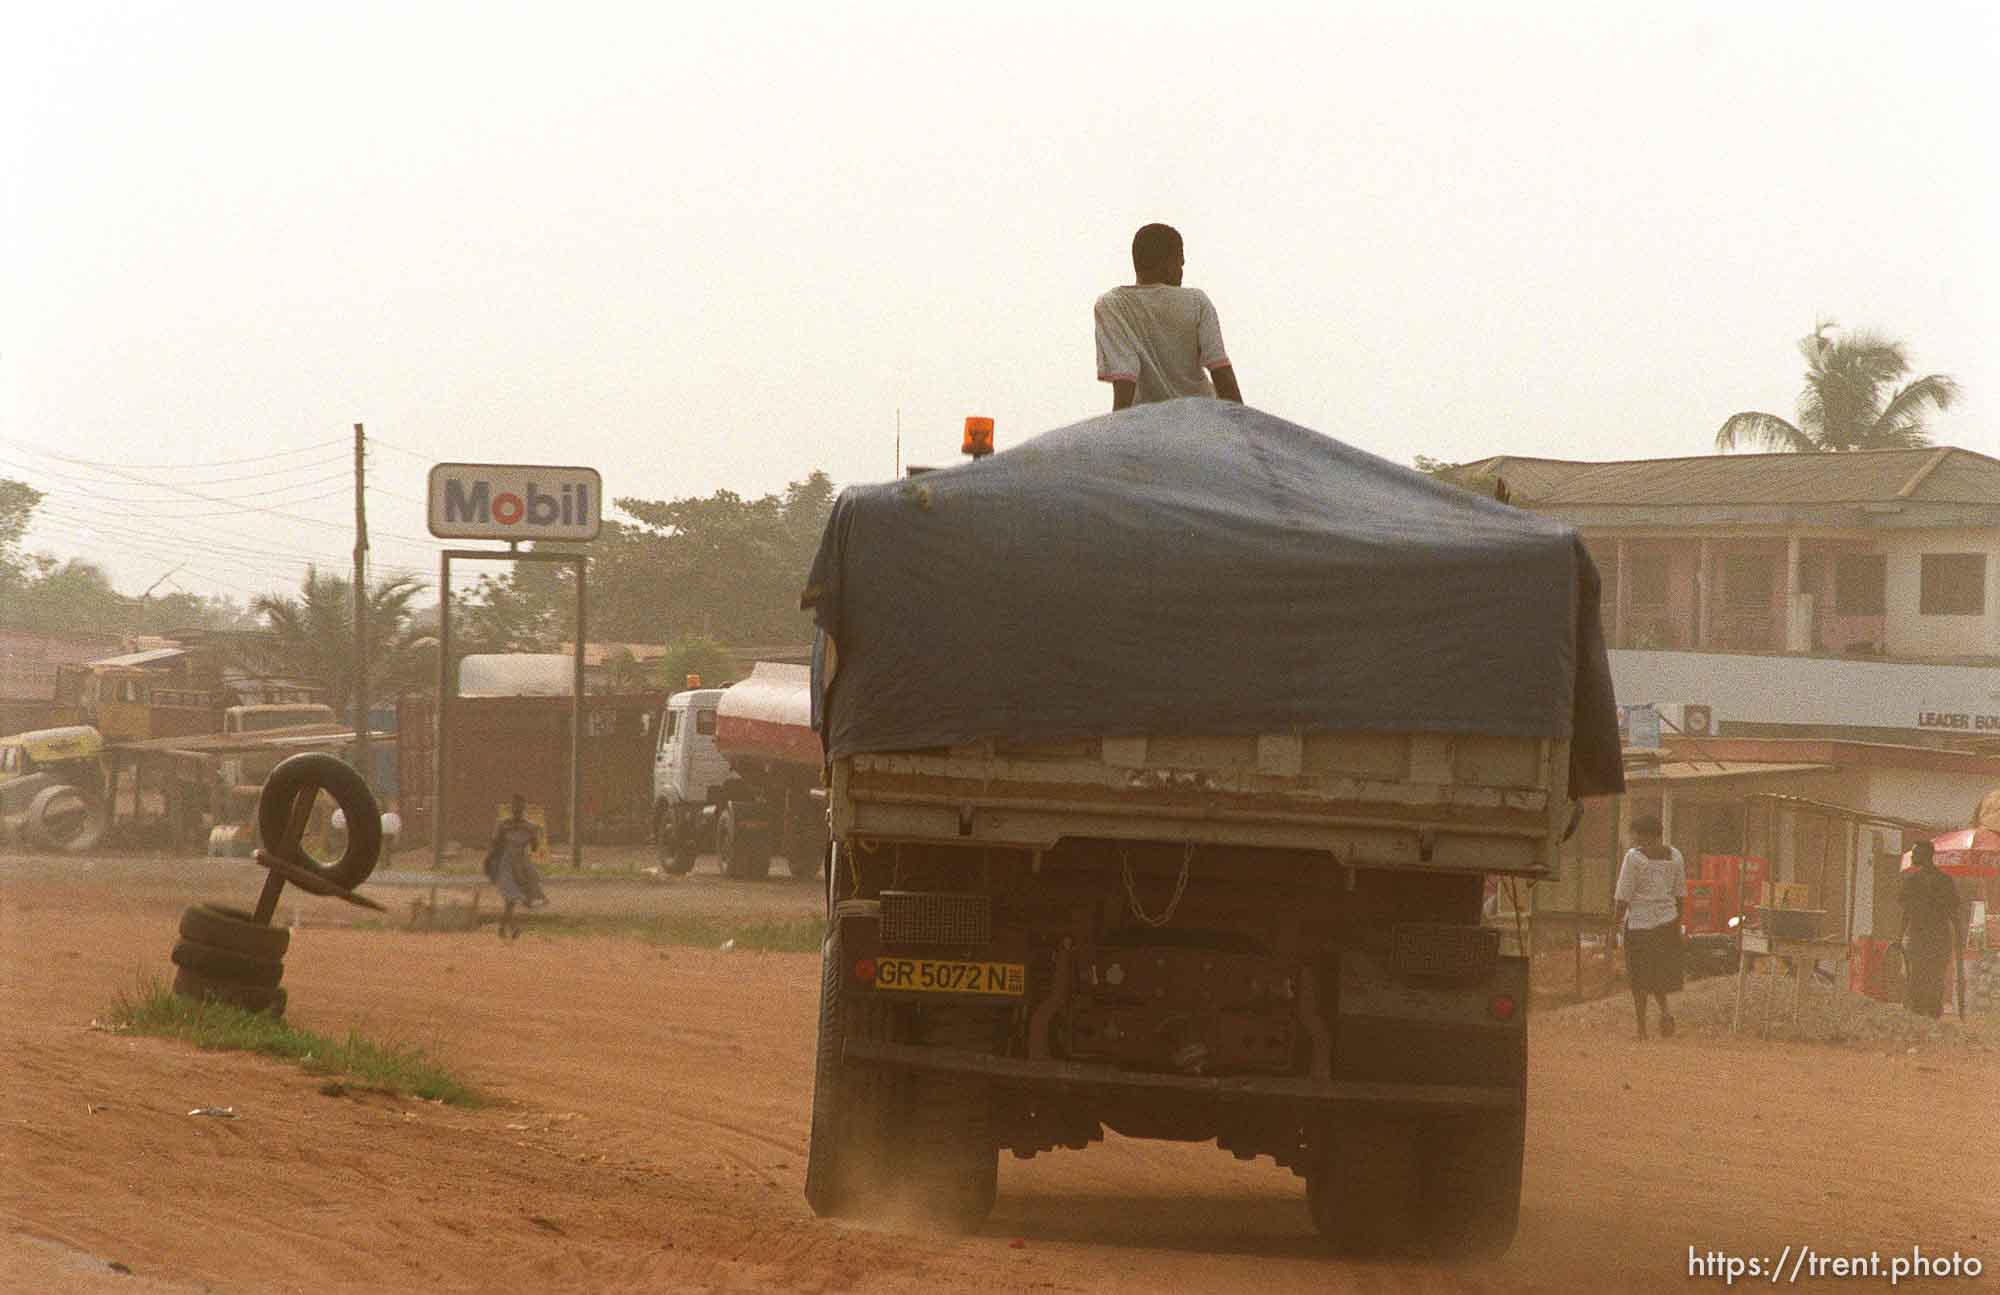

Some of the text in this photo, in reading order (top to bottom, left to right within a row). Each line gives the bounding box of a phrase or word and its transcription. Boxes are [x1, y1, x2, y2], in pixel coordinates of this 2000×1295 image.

[445, 479, 588, 525] Mobil
[1919, 711, 1969, 728] LEADER
[879, 961, 914, 986] GR
[921, 963, 981, 989] 5072
[987, 965, 1007, 991] N
